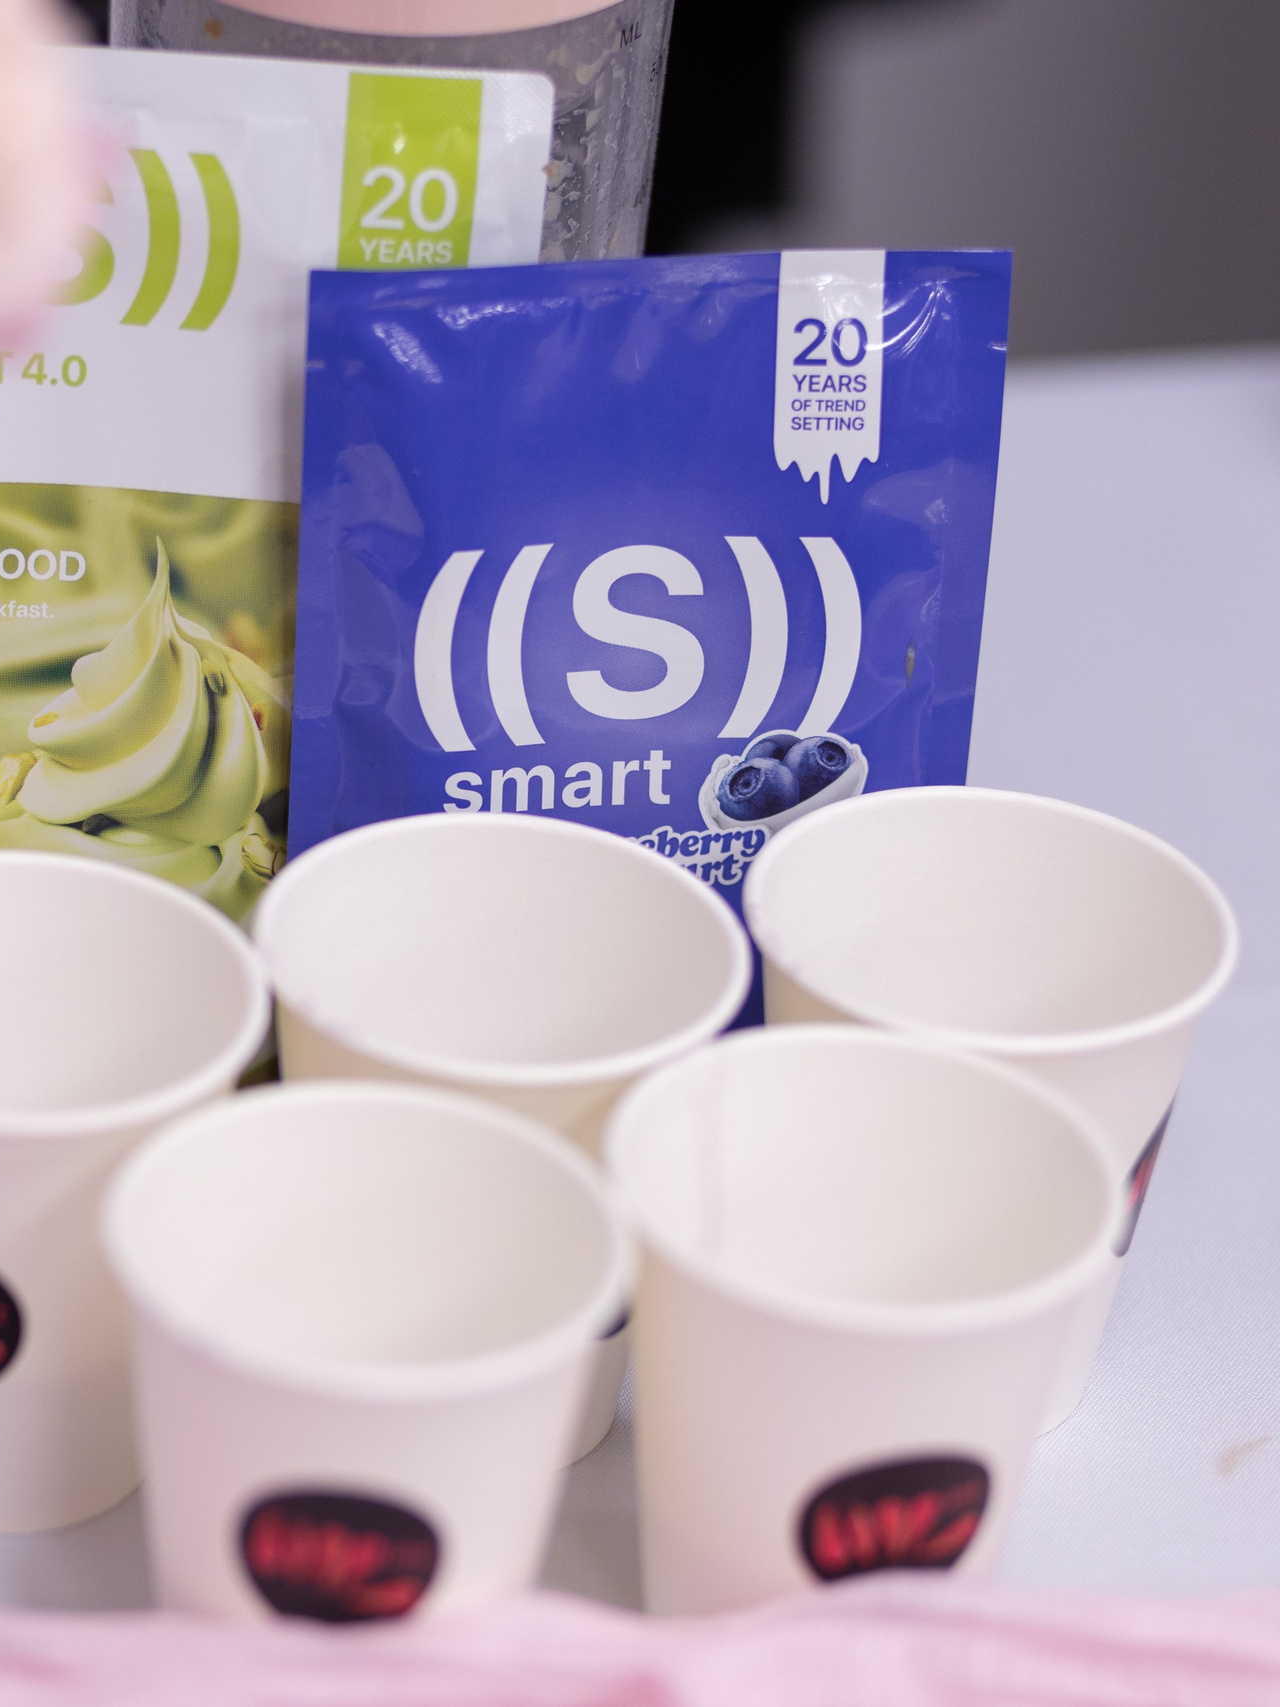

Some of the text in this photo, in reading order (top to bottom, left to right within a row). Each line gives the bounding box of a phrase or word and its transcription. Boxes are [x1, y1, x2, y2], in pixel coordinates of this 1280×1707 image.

[620, 21, 641, 49] ML
[360, 165, 458, 233] 20
[359, 238, 453, 265] YEARS
[793, 318, 868, 367] 20
[22, 353, 87, 387] 4.0
[792, 374, 867, 393] YEARS
[791, 399, 866, 412] OF TREND
[791, 416, 865, 431] SETTING
[443, 750, 671, 814] smart
